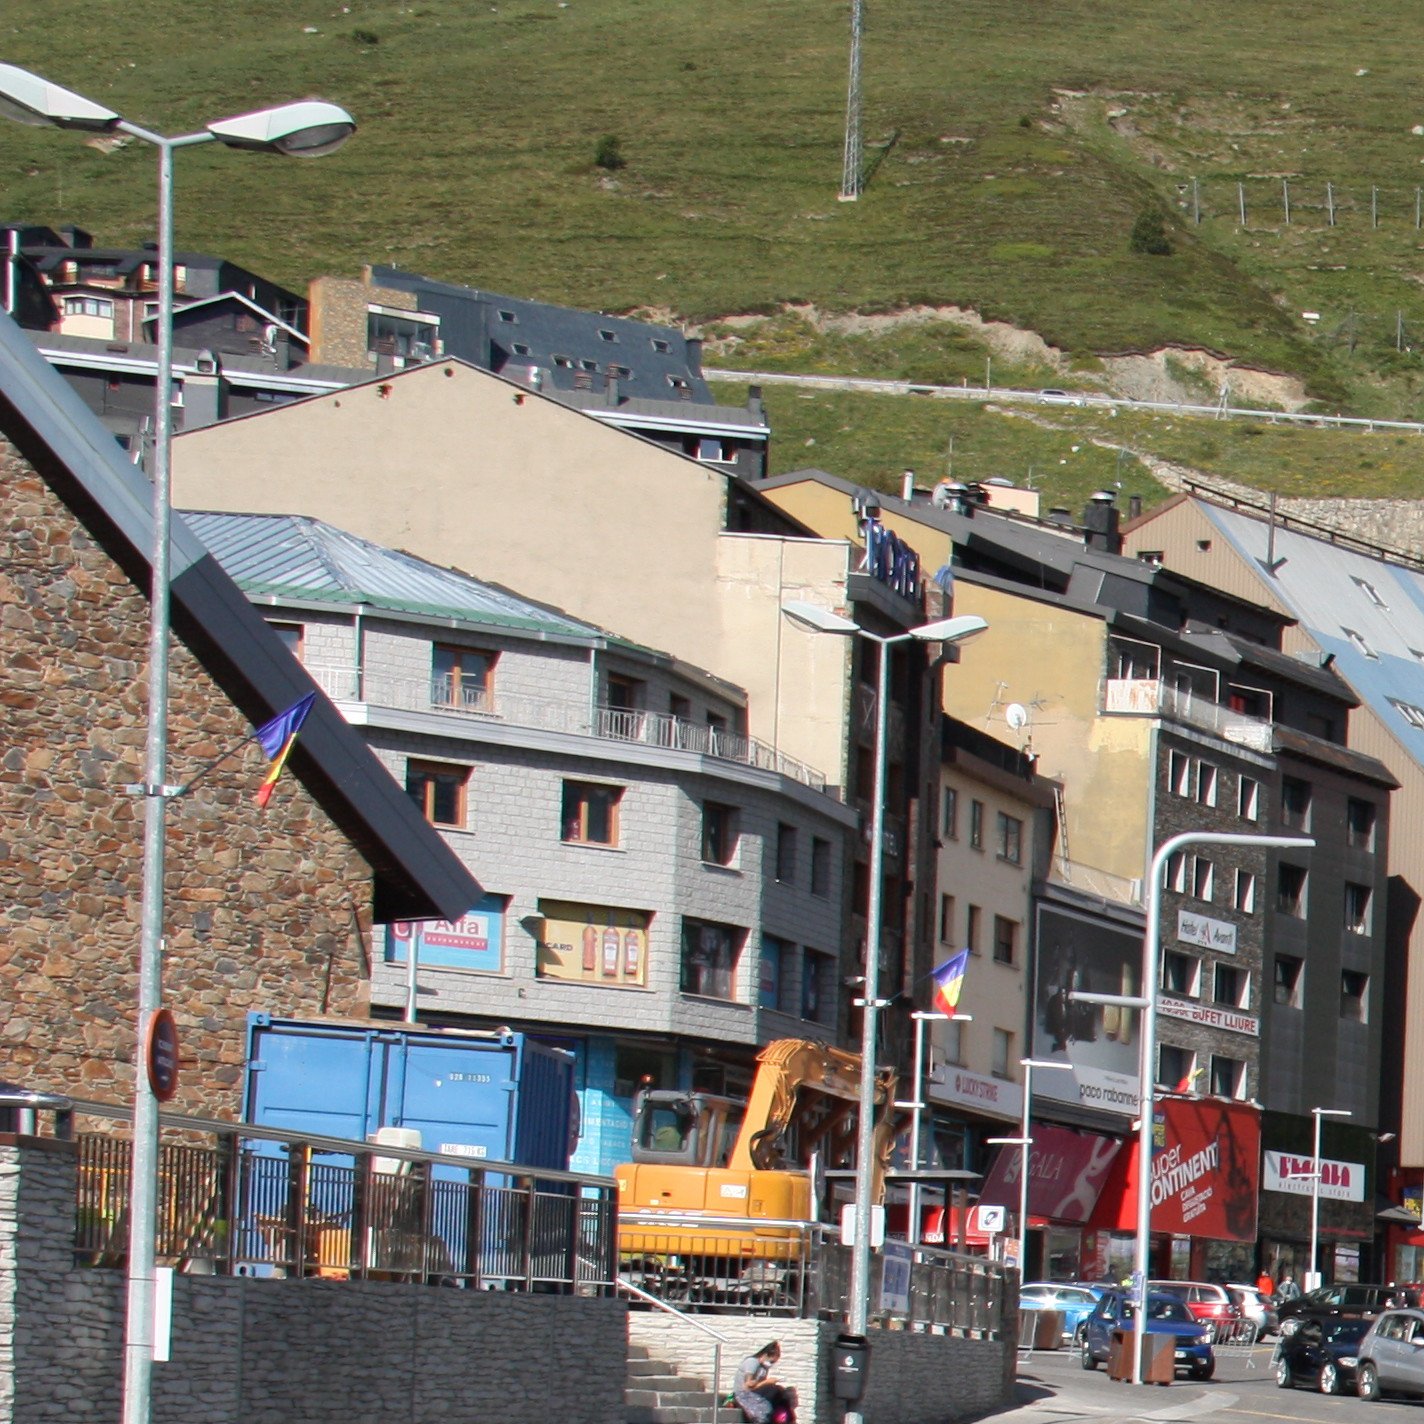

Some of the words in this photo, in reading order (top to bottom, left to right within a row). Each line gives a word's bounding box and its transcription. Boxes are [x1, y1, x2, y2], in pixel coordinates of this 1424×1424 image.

[1224, 1014, 1256, 1033] LLIURE
[1080, 1083, 1102, 1100] paco
[1102, 1087, 1139, 1107] rabanne
[1151, 1144, 1181, 1179] uper
[1151, 1142, 1219, 1209] ONTINENT
